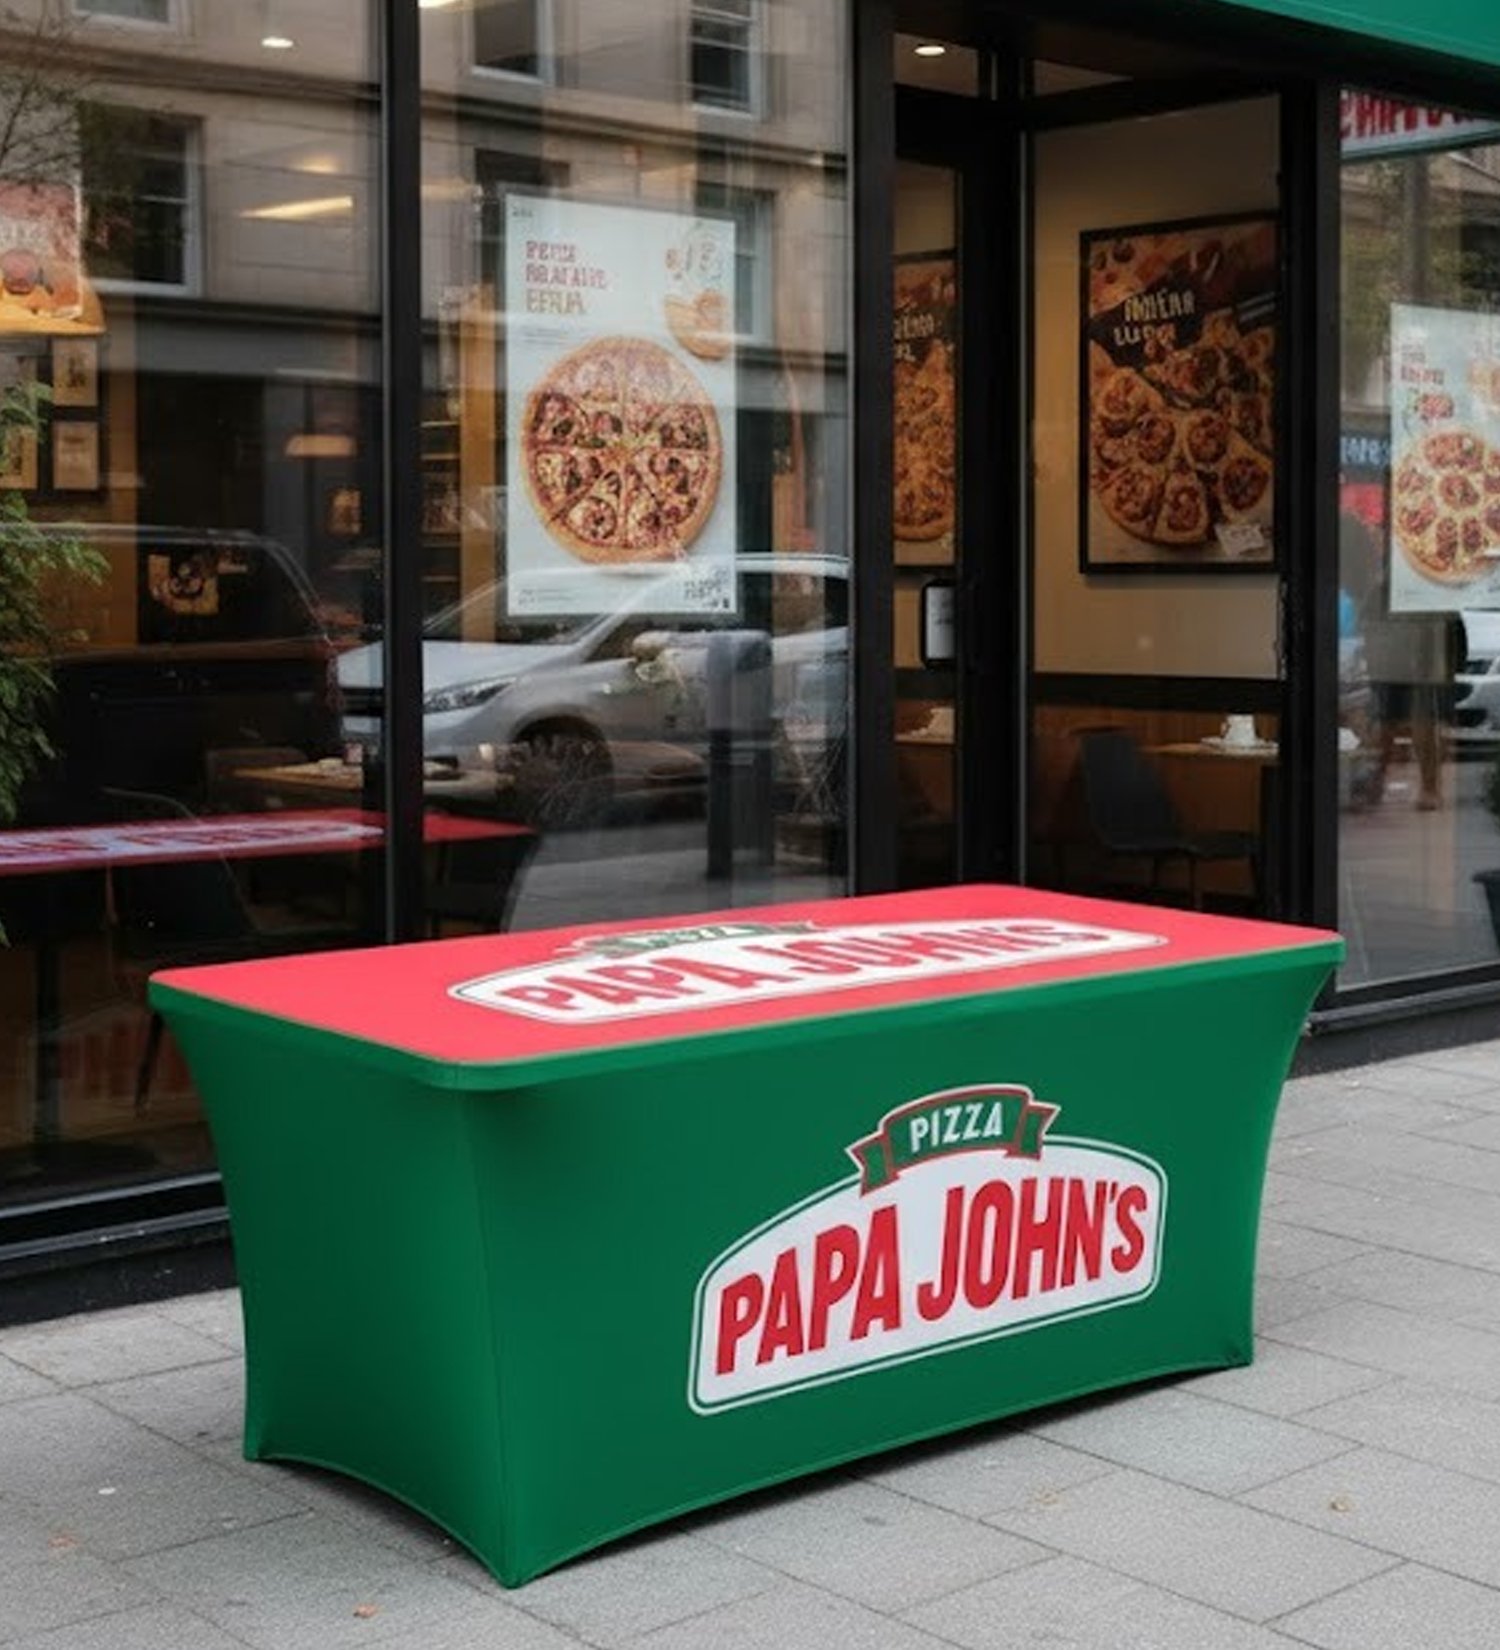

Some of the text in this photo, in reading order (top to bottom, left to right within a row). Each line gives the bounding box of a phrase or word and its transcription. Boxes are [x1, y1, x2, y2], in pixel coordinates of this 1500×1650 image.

[496, 957, 803, 1012] PAPA
[741, 925, 1111, 975] JOHN'S
[910, 1101, 1002, 1153] PIZZA
[716, 1177, 1148, 1375] PAPA JOHN'S
